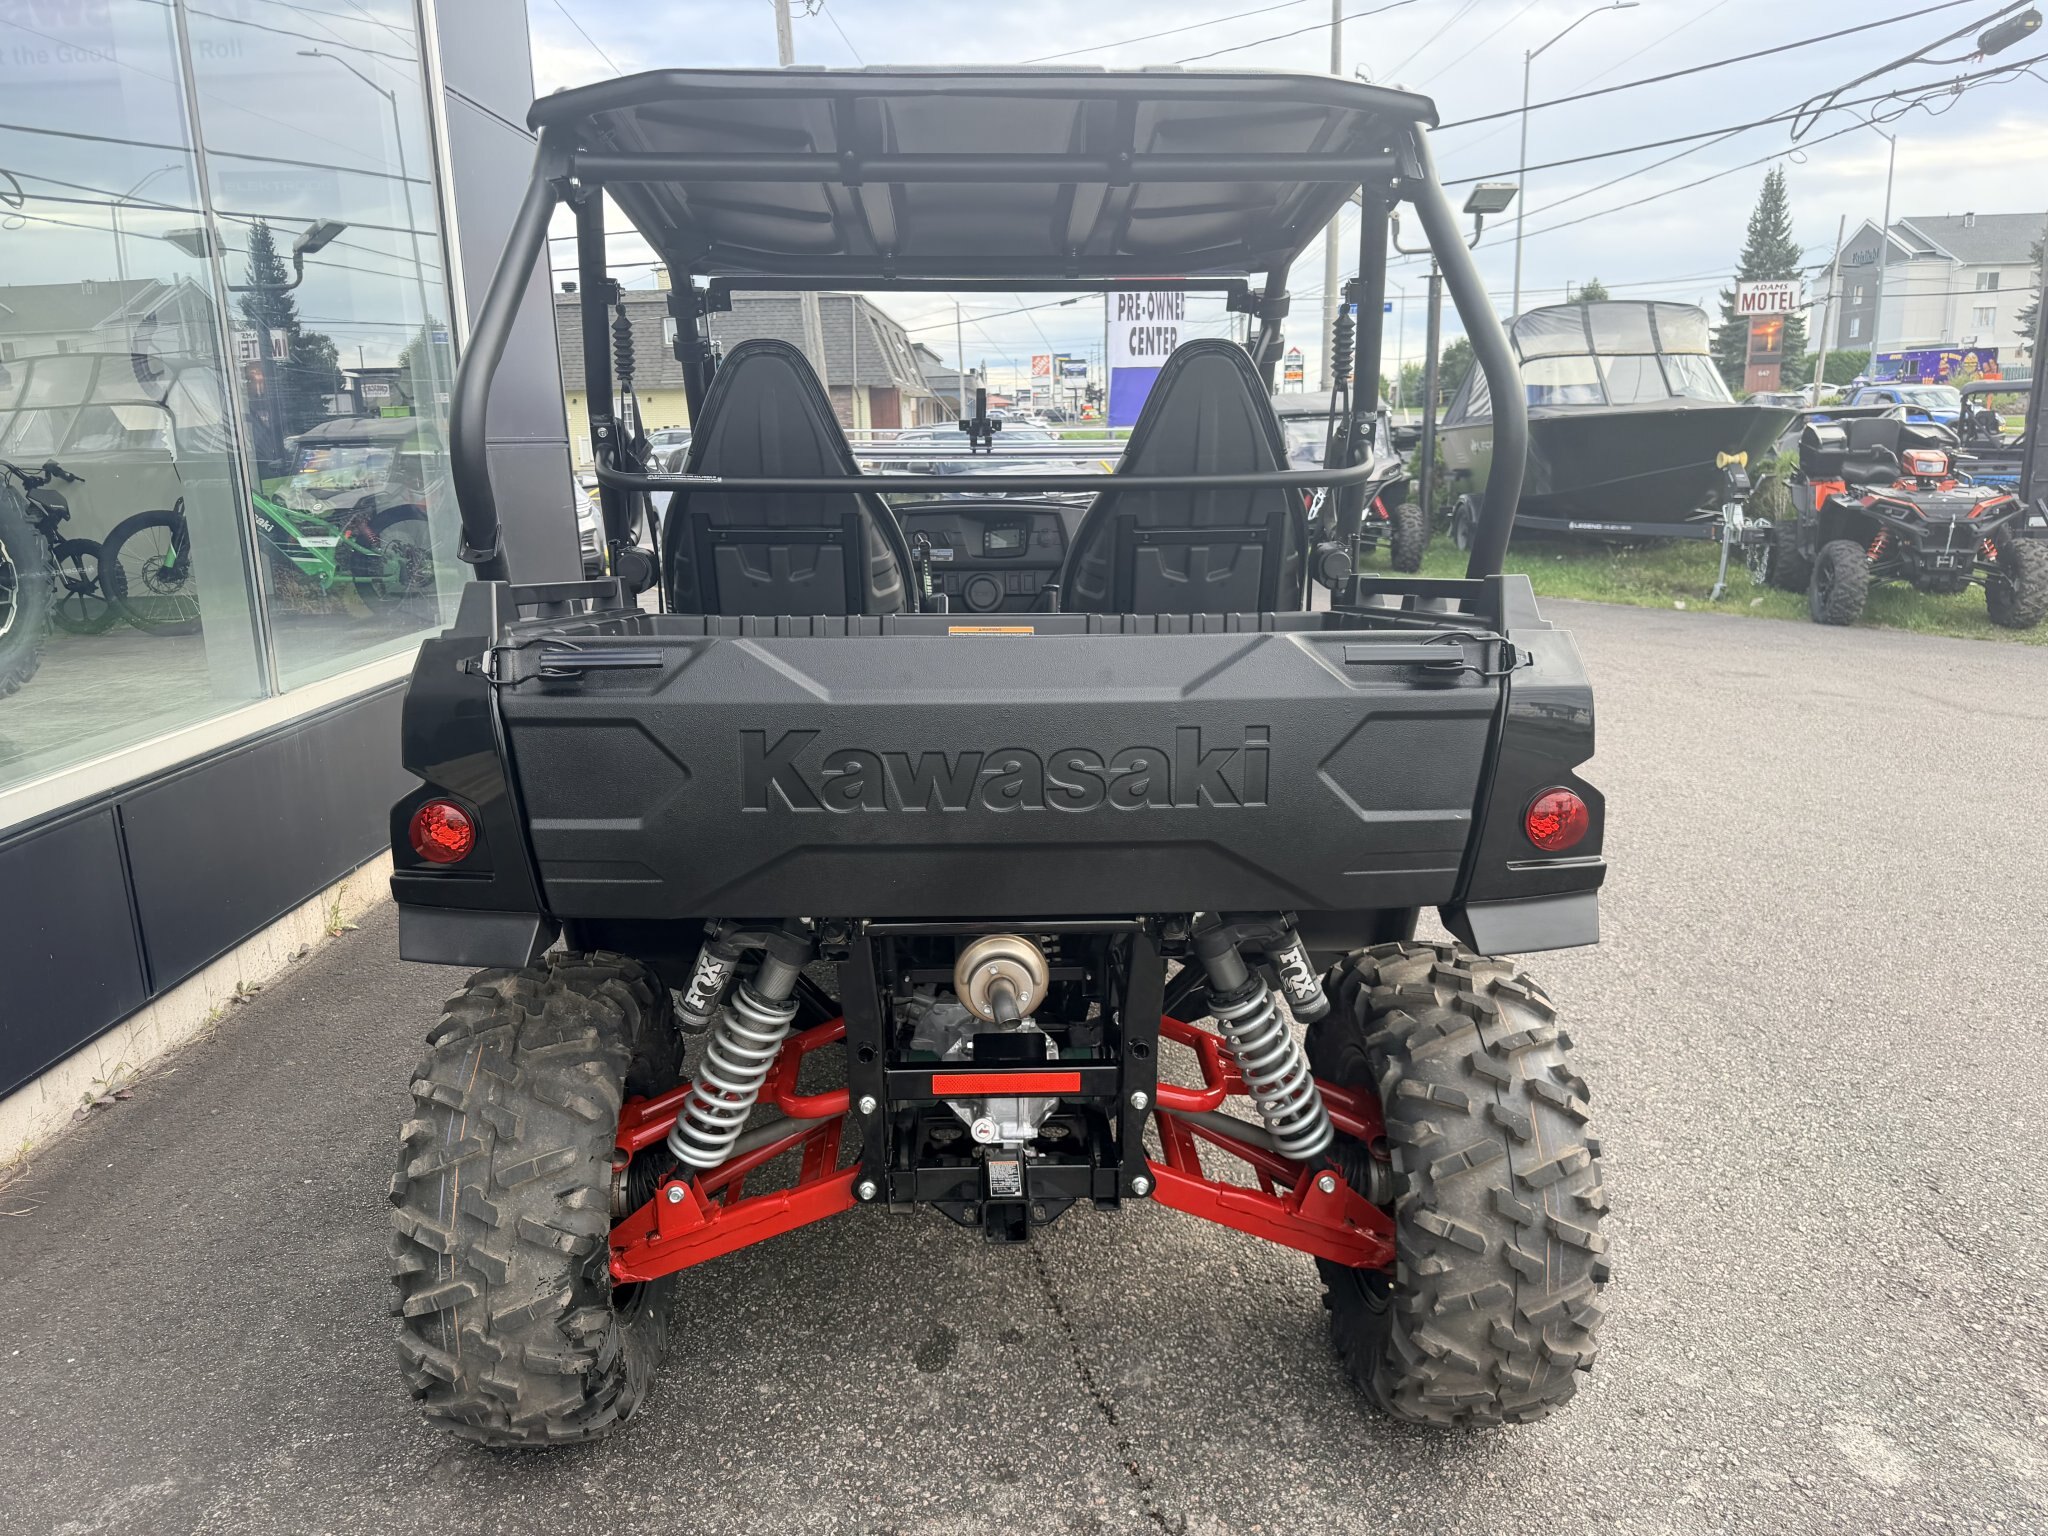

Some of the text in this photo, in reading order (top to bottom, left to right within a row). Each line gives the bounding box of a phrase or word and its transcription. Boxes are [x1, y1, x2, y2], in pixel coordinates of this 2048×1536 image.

[1741, 291, 1796, 312] MOTEL
[1752, 282, 1789, 292] ADAMS
[1129, 326, 1178, 357] CENTER
[739, 725, 1271, 813] Kawasaki
[685, 956, 726, 1010] FOX
[1279, 946, 1317, 1000] FOX
